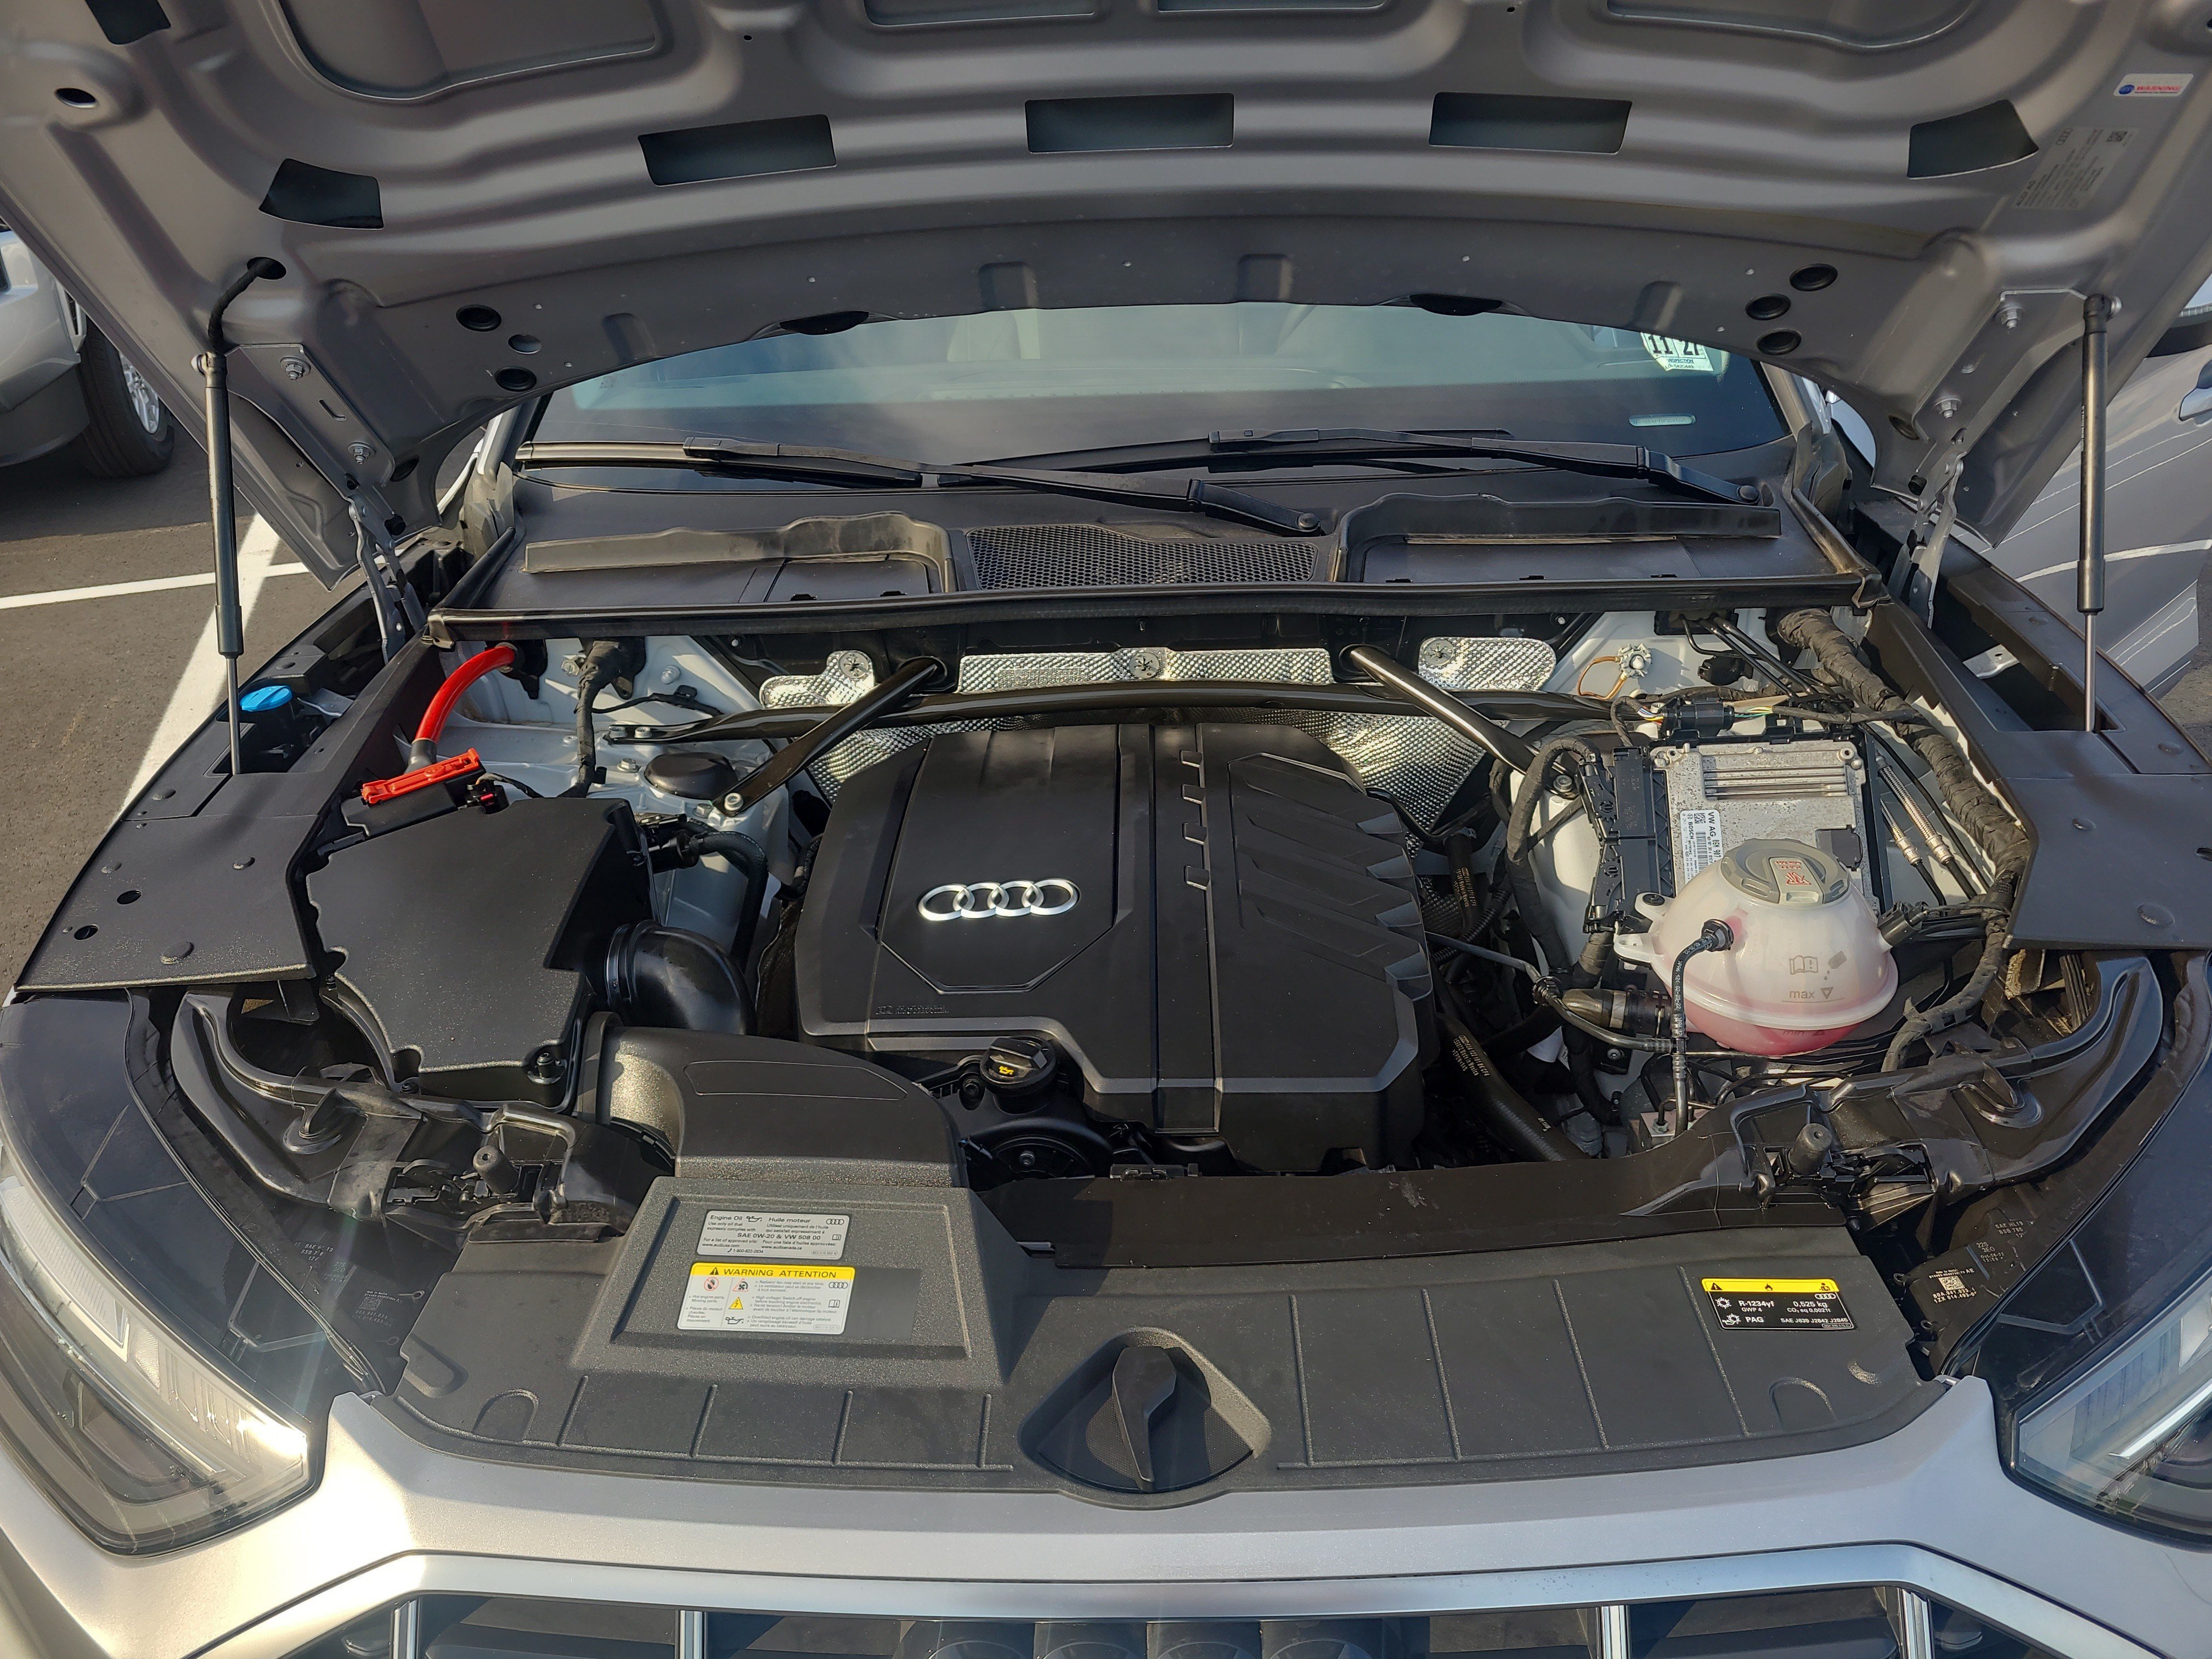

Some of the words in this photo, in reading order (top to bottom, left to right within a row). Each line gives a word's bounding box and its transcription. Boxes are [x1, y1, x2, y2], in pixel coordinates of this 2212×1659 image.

[1648, 335, 1673, 354] 11
[1708, 812, 1715, 823] VW
[1709, 826, 1717, 837] AG
